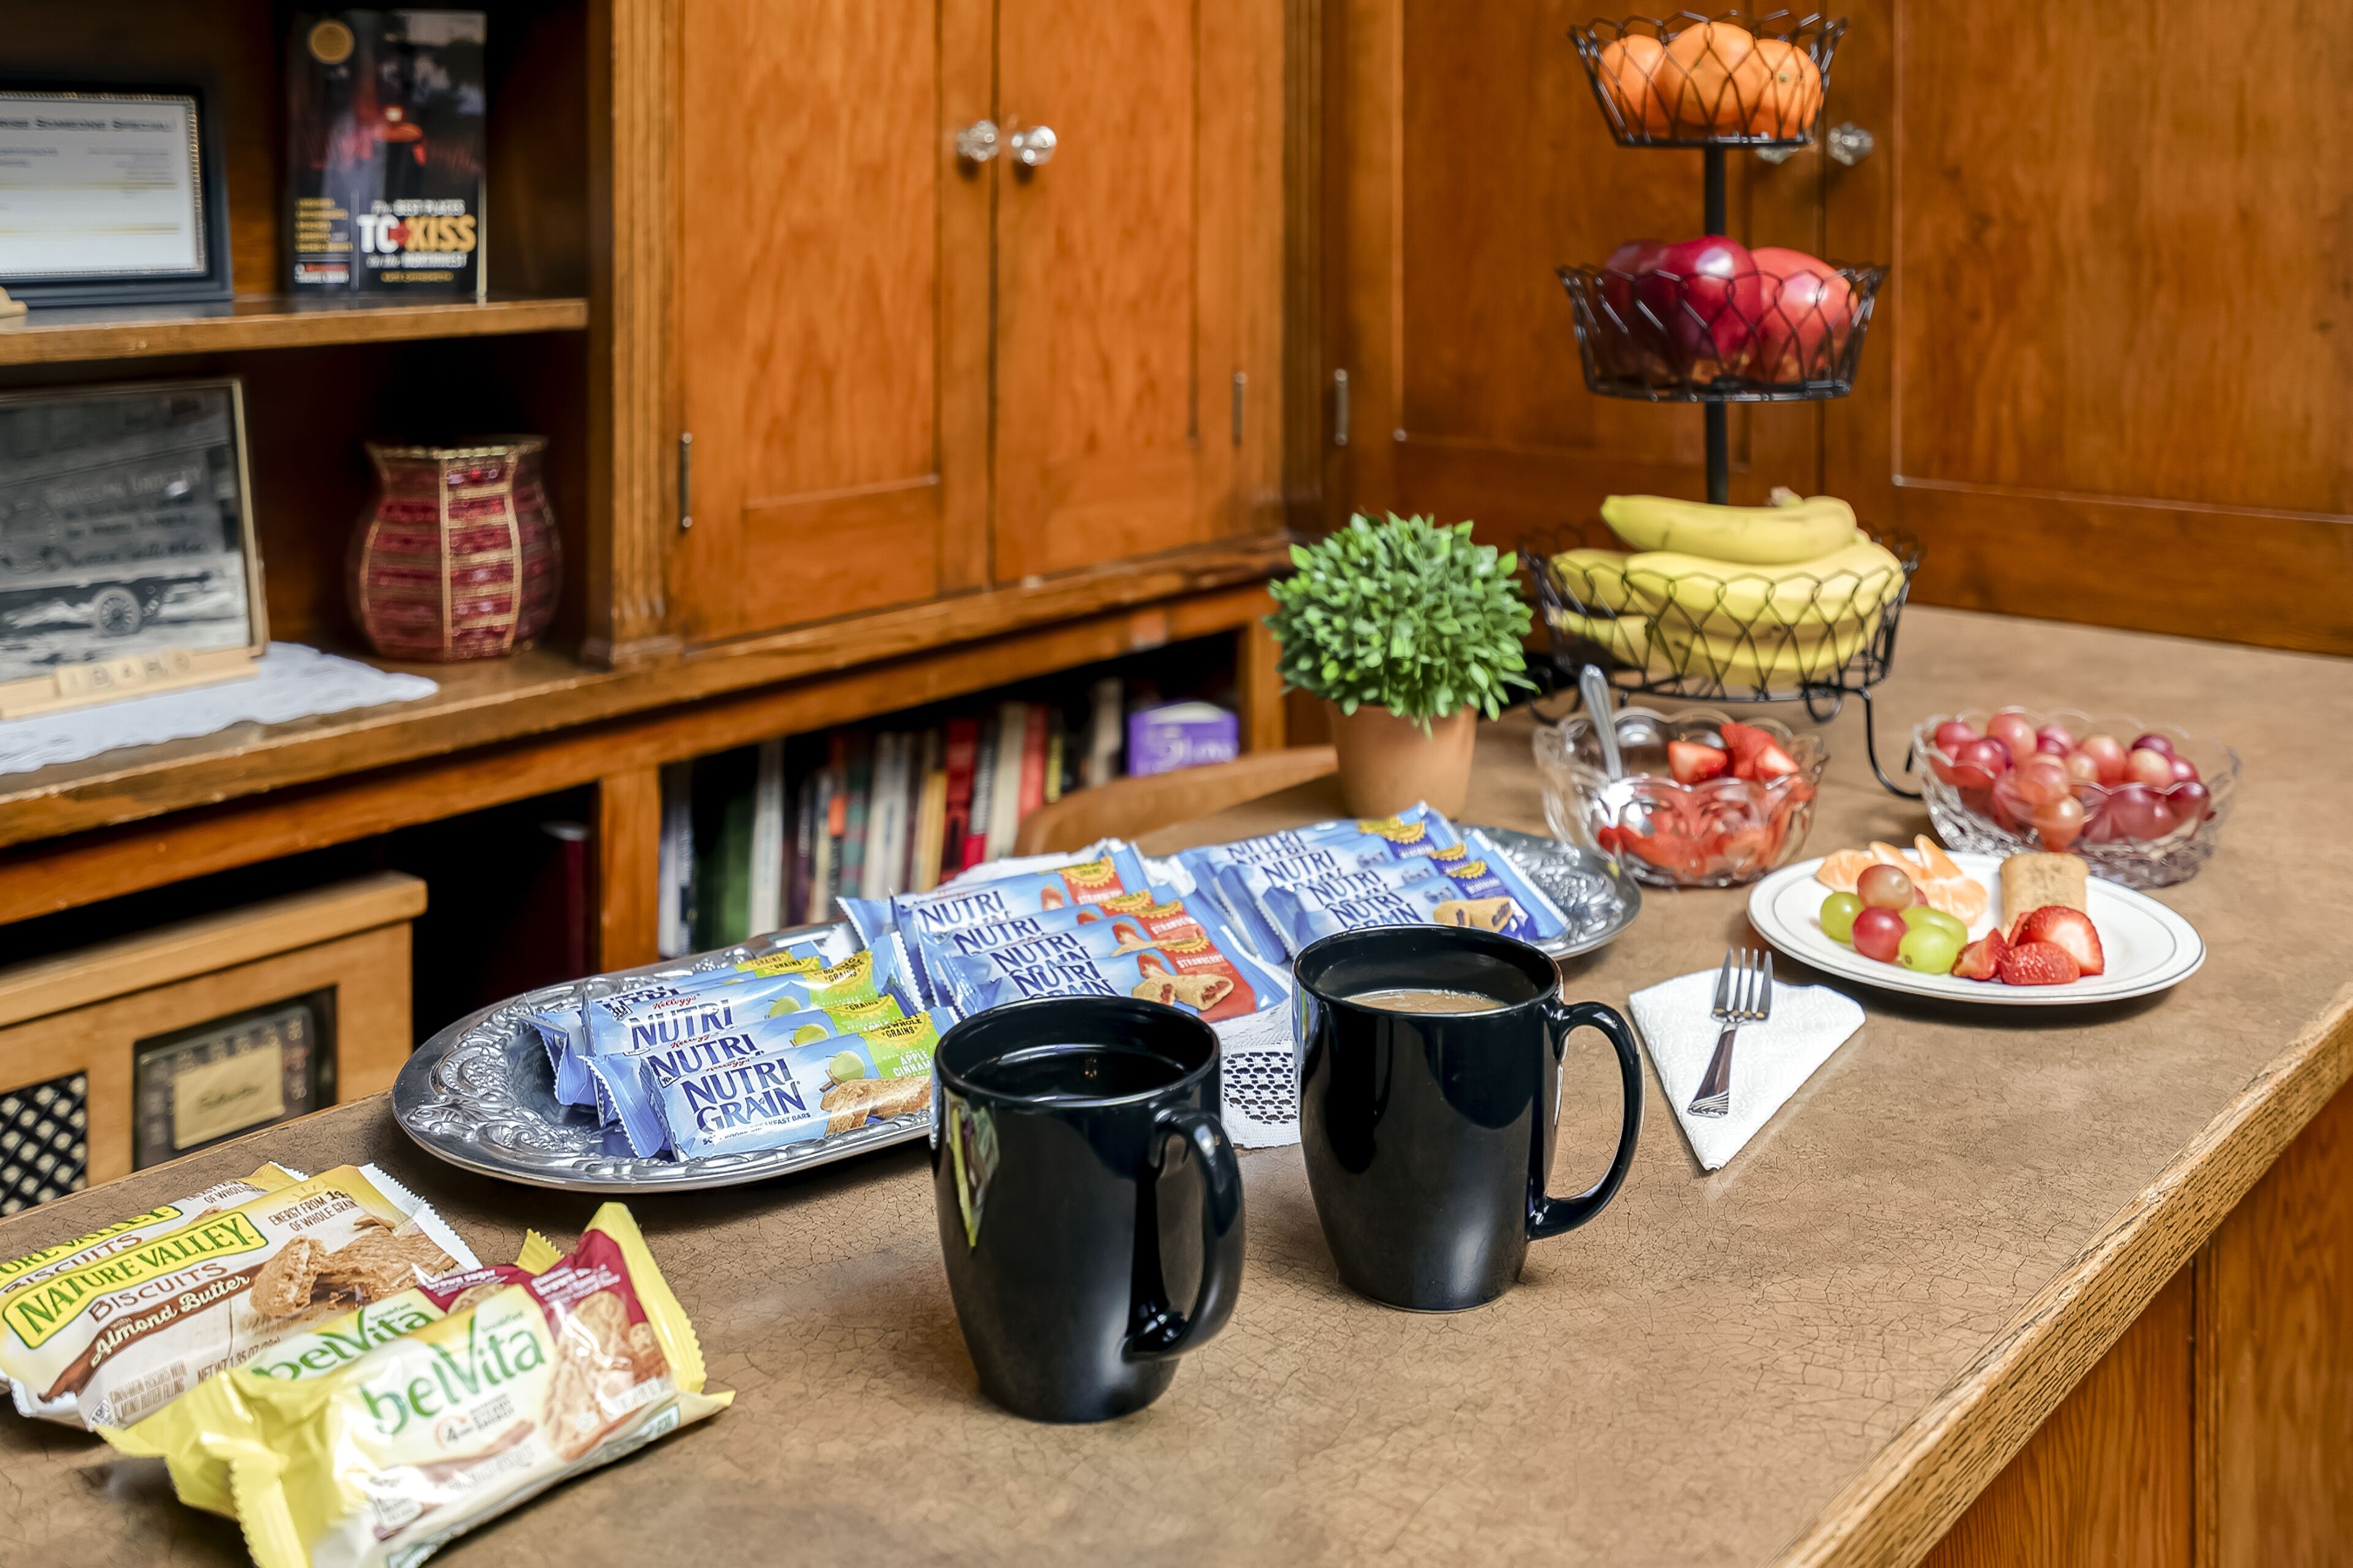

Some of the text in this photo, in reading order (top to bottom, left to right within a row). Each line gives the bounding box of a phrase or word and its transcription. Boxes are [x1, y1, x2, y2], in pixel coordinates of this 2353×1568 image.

[1261, 849, 1336, 887] NUTRI
[1308, 869, 1381, 906] NUTRI
[918, 890, 1006, 933] NUTRI
[1330, 892, 1404, 929] NUTRI
[953, 917, 1042, 955] NUTRI
[990, 933, 1080, 974] NUTRI
[1012, 960, 1102, 999] NUTRI
[652, 995, 697, 1010] Kellogg's
[629, 999, 733, 1050] NUTRI
[885, 1026, 915, 1038] GRAINS
[647, 1033, 759, 1078] NUTRI
[893, 1059, 932, 1077] CINNAM
[900, 1049, 930, 1066] APPLE
[680, 1058, 794, 1115] NUTRI
[696, 1080, 808, 1134] GRAIN
[792, 1112, 811, 1122] BARS
[268, 1208, 303, 1225] ENERGY
[299, 1197, 328, 1217] FROM
[289, 1219, 306, 1232] OF
[301, 1205, 336, 1227] WHOLE
[17, 1218, 252, 1336] NATURE VALLEY
[88, 1263, 227, 1322] BISCUITS
[90, 1274, 250, 1368] Almond Butter
[251, 1307, 434, 1381] belVita
[359, 1316, 545, 1435] belVita
